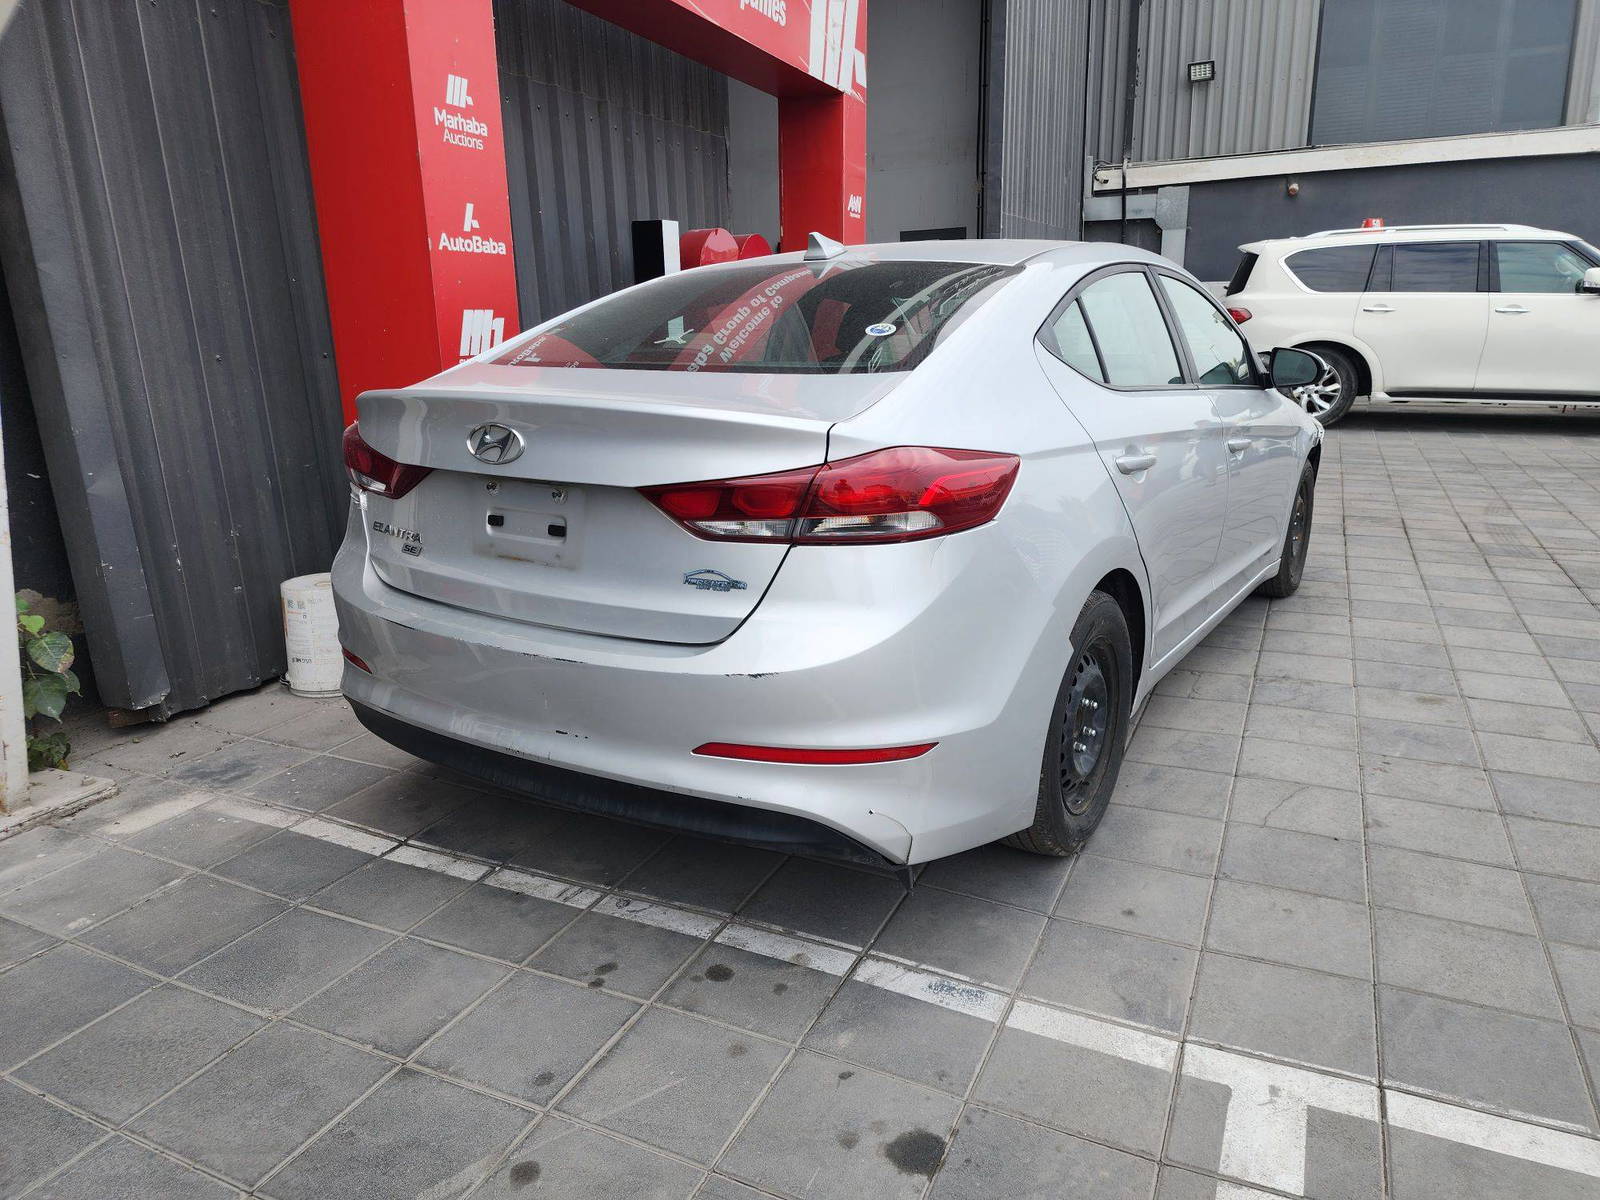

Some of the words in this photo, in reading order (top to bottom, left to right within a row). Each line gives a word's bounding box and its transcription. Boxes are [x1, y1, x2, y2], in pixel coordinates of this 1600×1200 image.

[433, 106, 488, 137] Marhaba
[442, 128, 484, 150] Auctions
[438, 232, 507, 255] AutoBaba
[372, 520, 423, 545] ELANTRA
